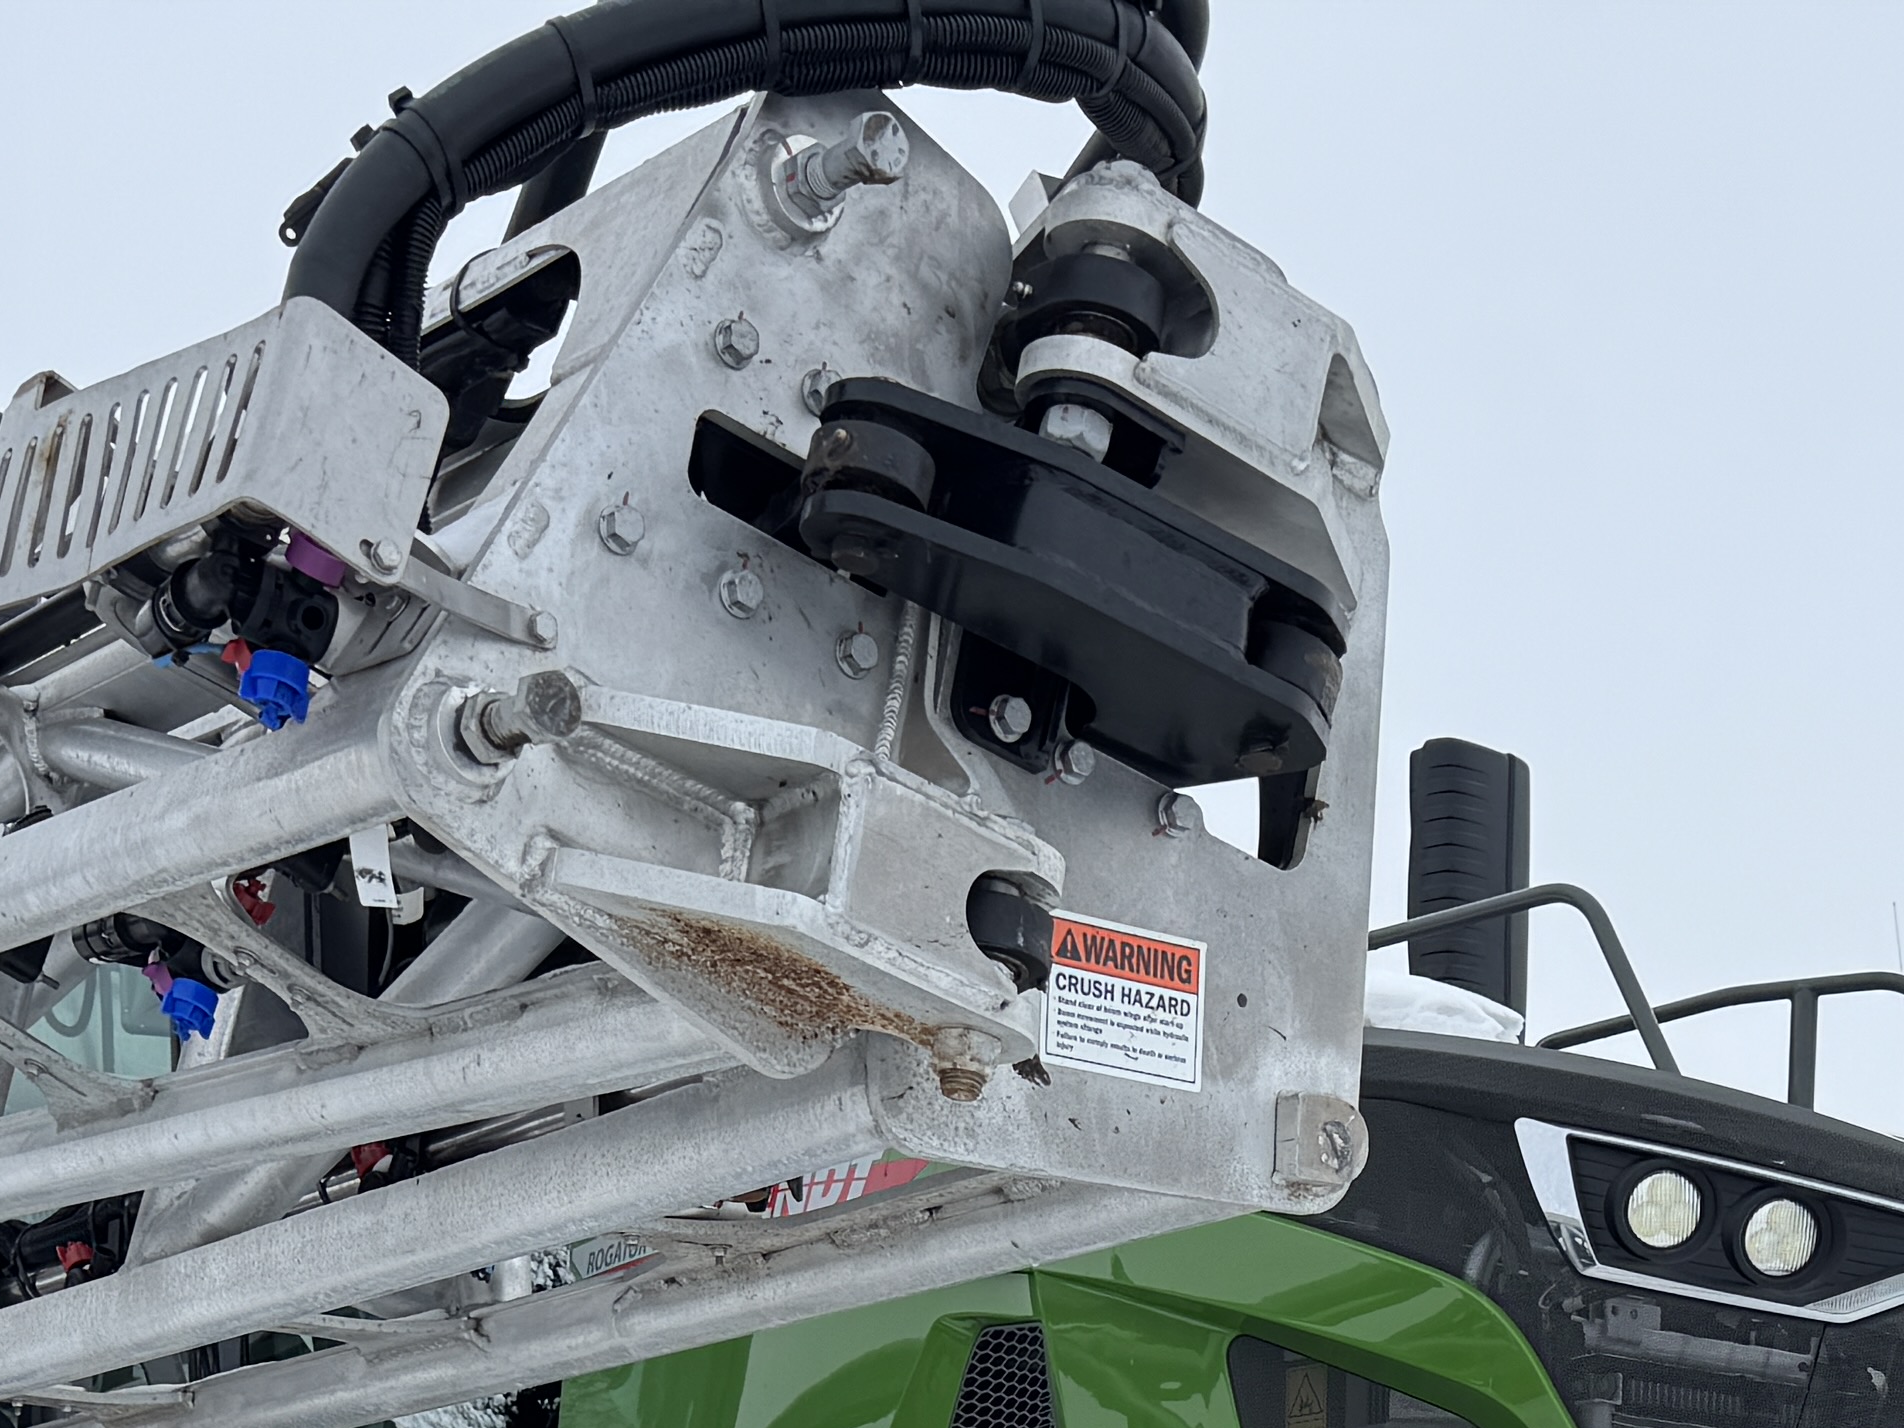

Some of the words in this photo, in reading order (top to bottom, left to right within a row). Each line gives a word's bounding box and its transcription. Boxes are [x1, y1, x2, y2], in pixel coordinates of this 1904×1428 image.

[1082, 932, 1192, 985] WARNING
[1055, 972, 1115, 1002] CRUSH
[1121, 986, 1191, 1017] HAZARD
[763, 1150, 885, 1219] NDT
